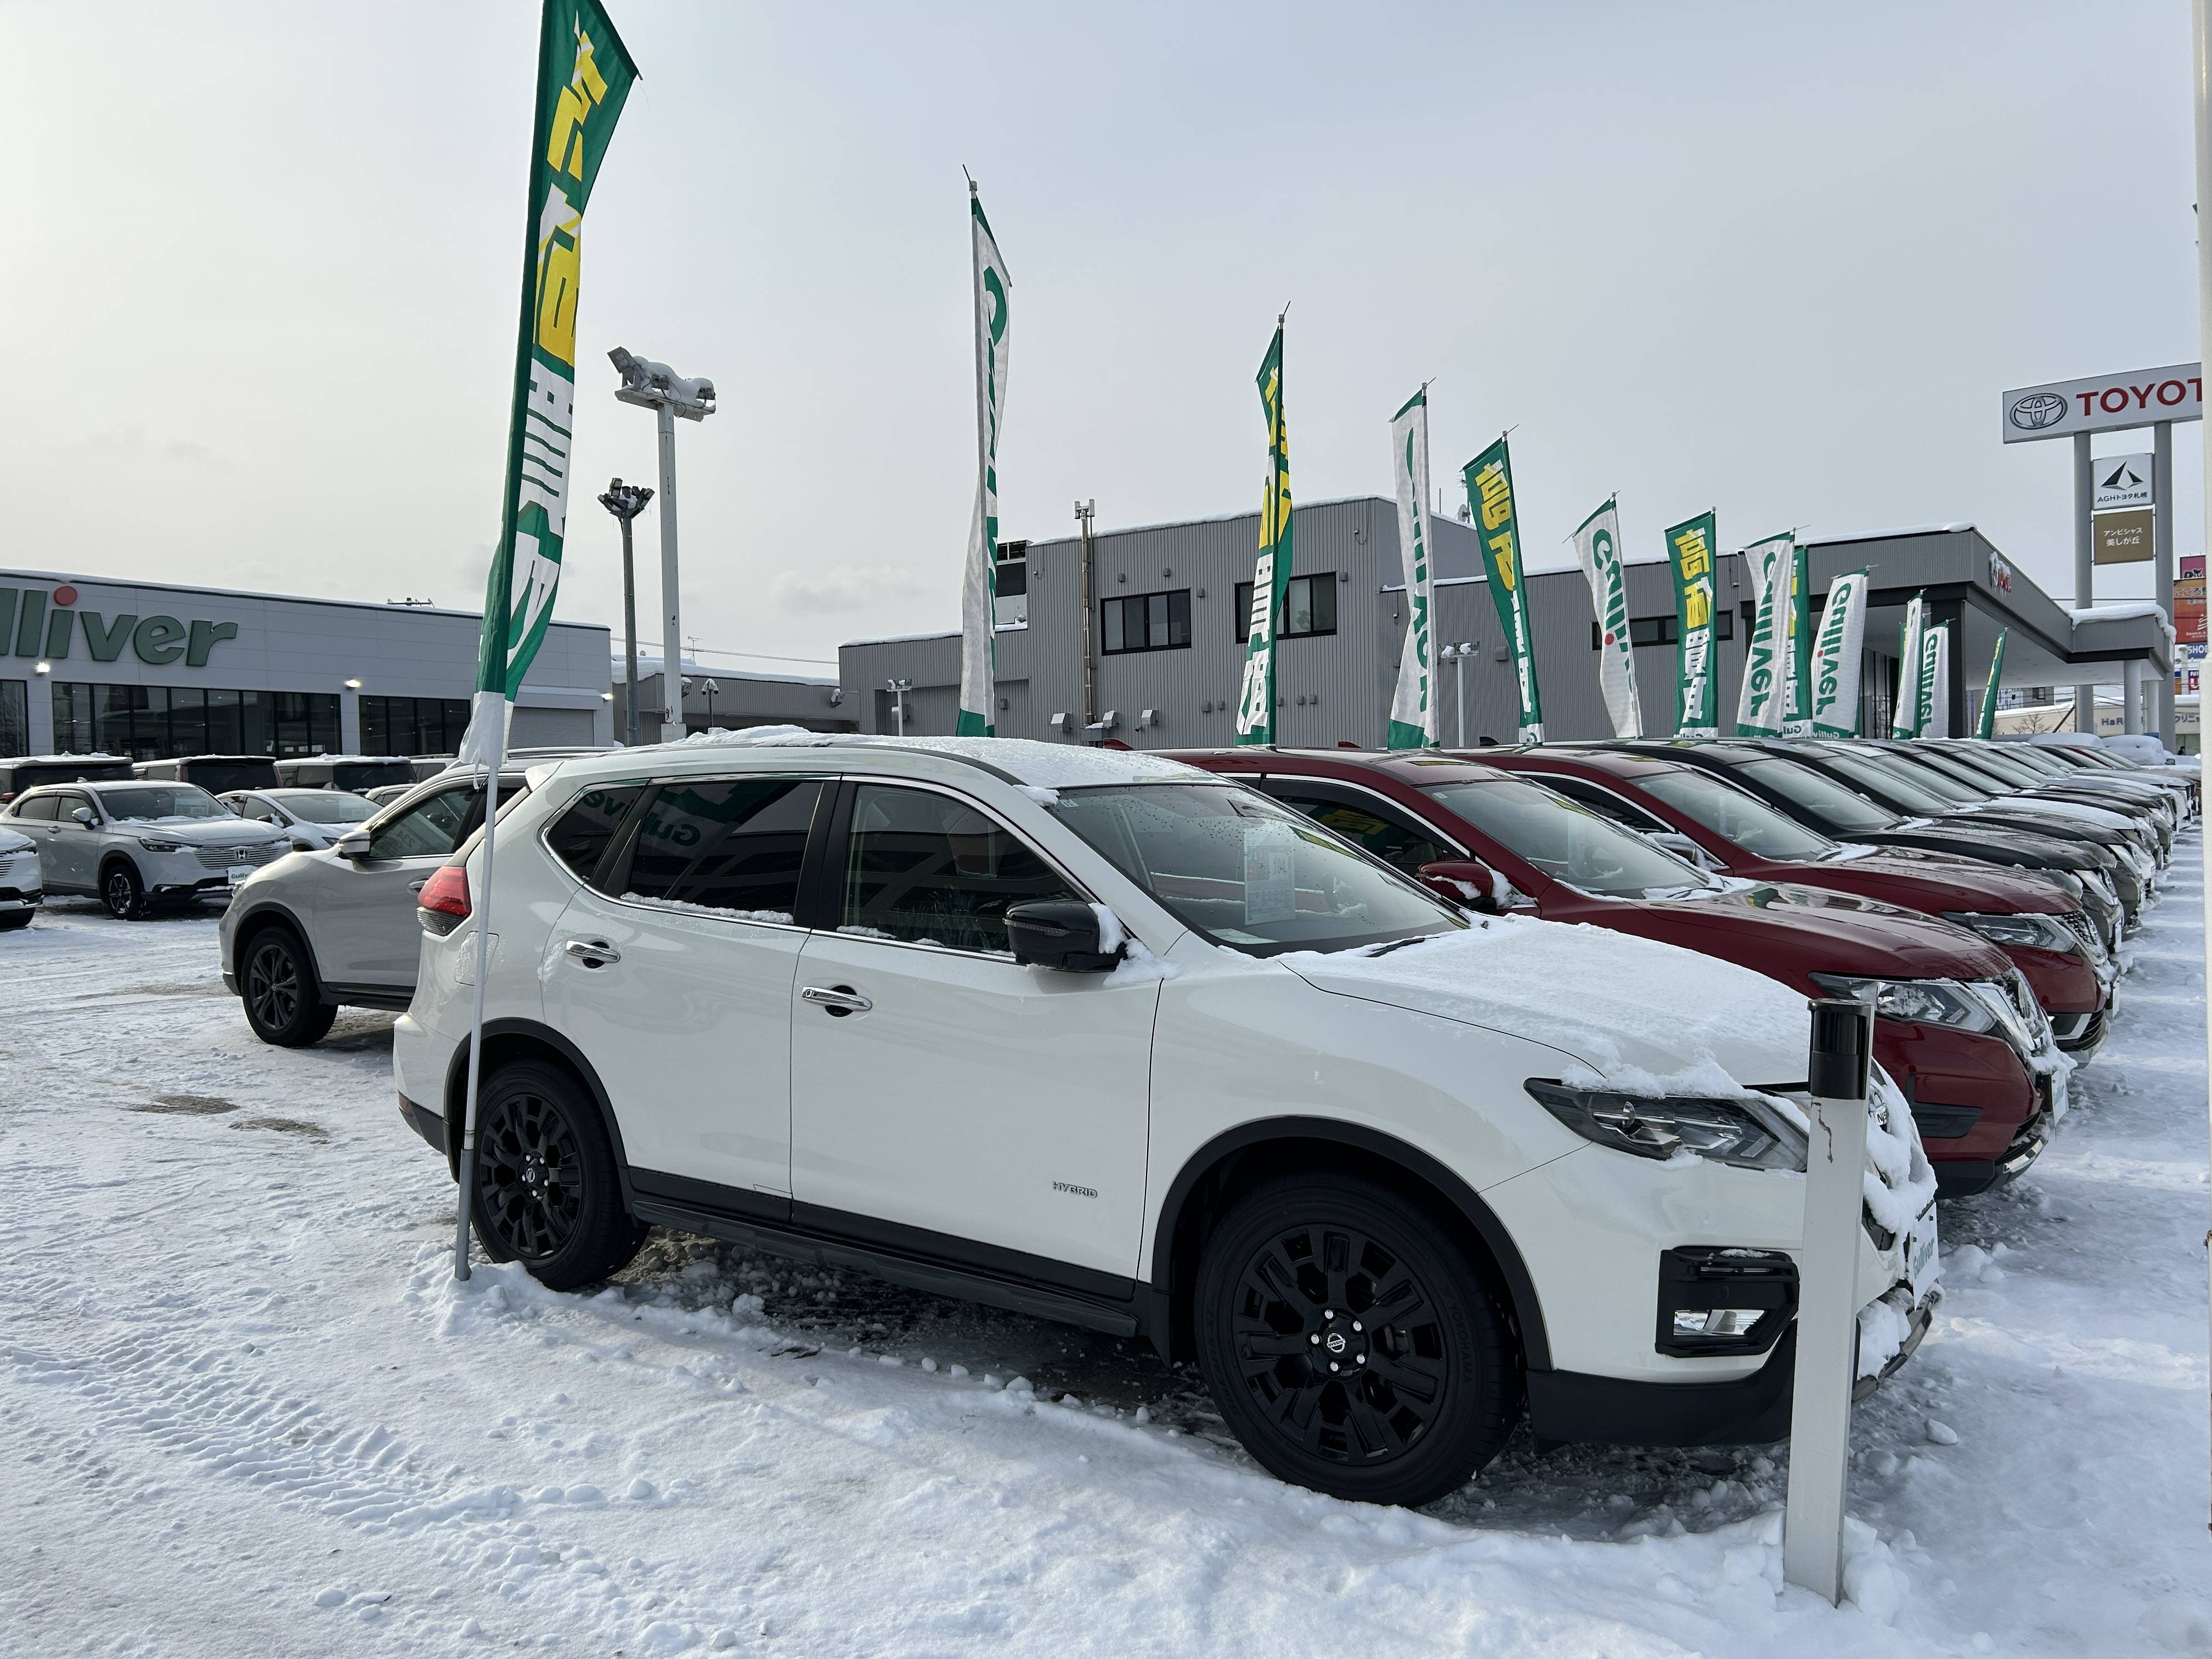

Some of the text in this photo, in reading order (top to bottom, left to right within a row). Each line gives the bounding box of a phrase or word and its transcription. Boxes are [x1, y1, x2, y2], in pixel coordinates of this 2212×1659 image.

[2097, 492, 2147, 503] AGHトヨタ札幌
[2103, 527, 2142, 537] アンビシャス
[2106, 536, 2140, 546] 美しが丘
[1052, 1181, 1098, 1198] HYBRID
